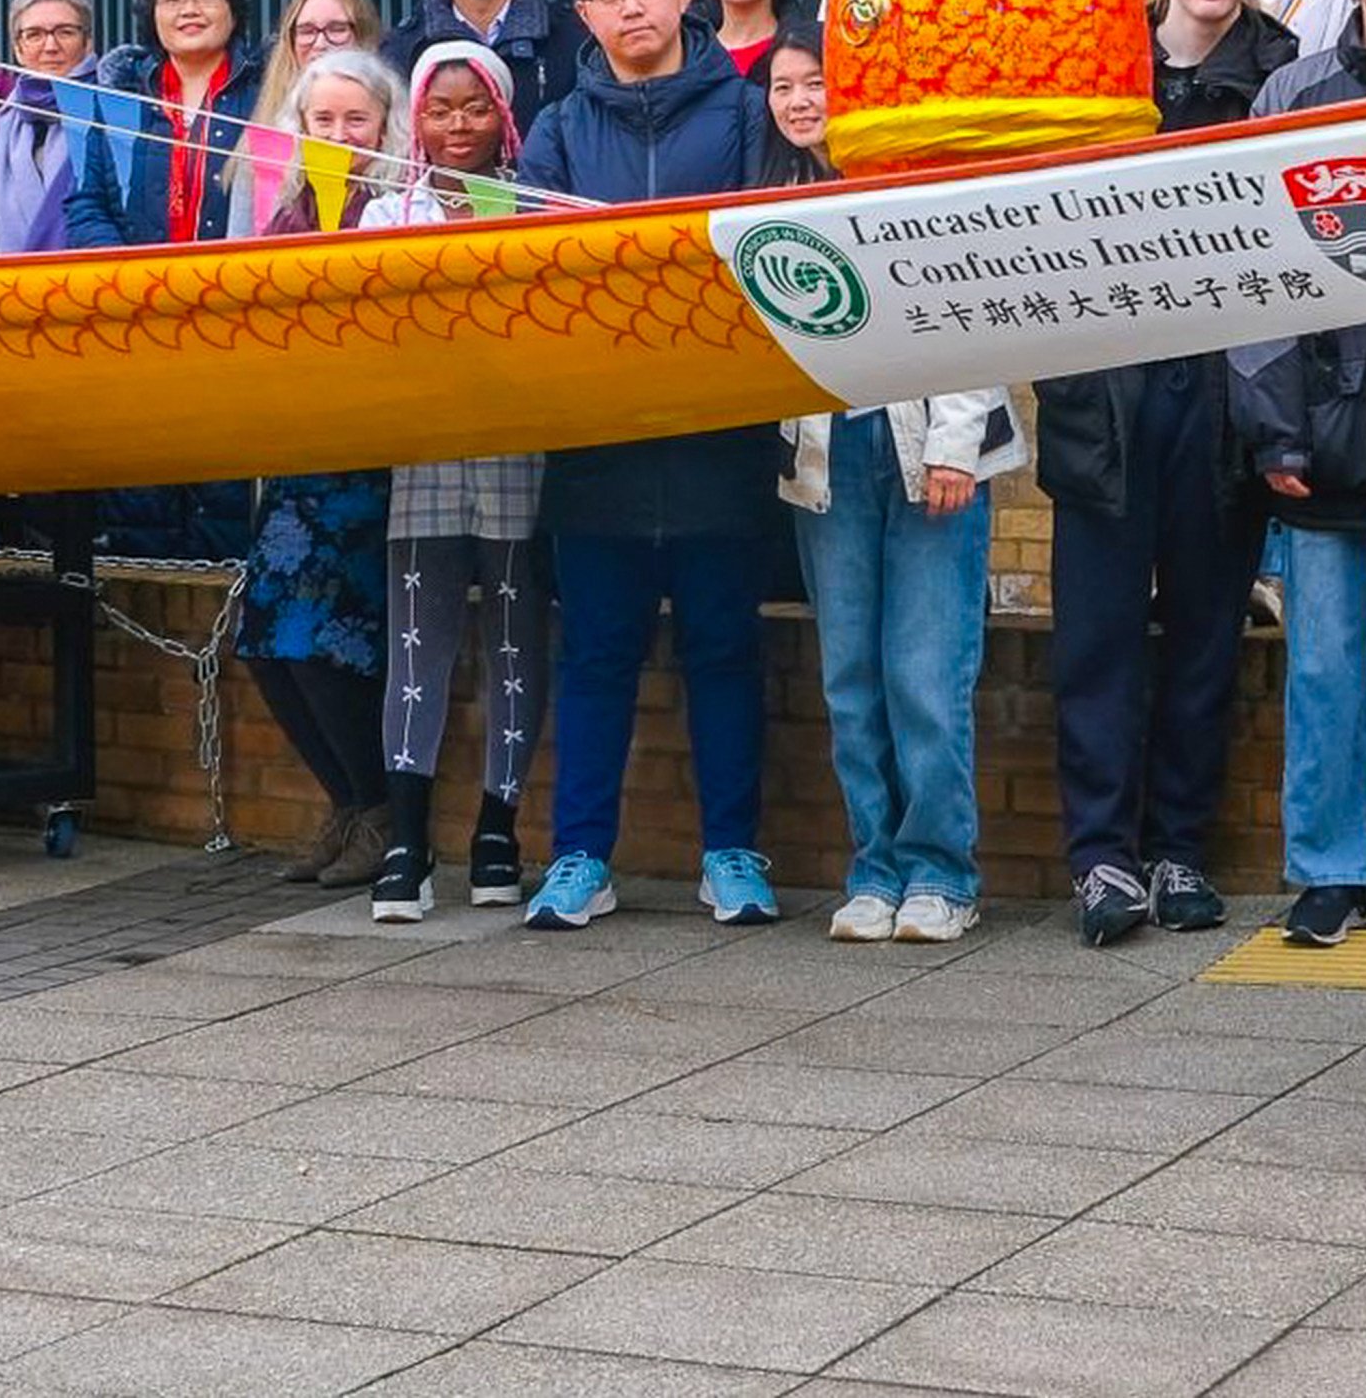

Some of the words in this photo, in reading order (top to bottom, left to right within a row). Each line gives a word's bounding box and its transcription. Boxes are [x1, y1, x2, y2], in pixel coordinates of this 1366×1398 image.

[847, 202, 1042, 246] Lancaster
[1049, 171, 1267, 223] University
[888, 245, 1089, 288] Confucius
[1091, 223, 1275, 267] Institute
[904, 268, 1326, 334] 兰卡斯特大学孔子学院
